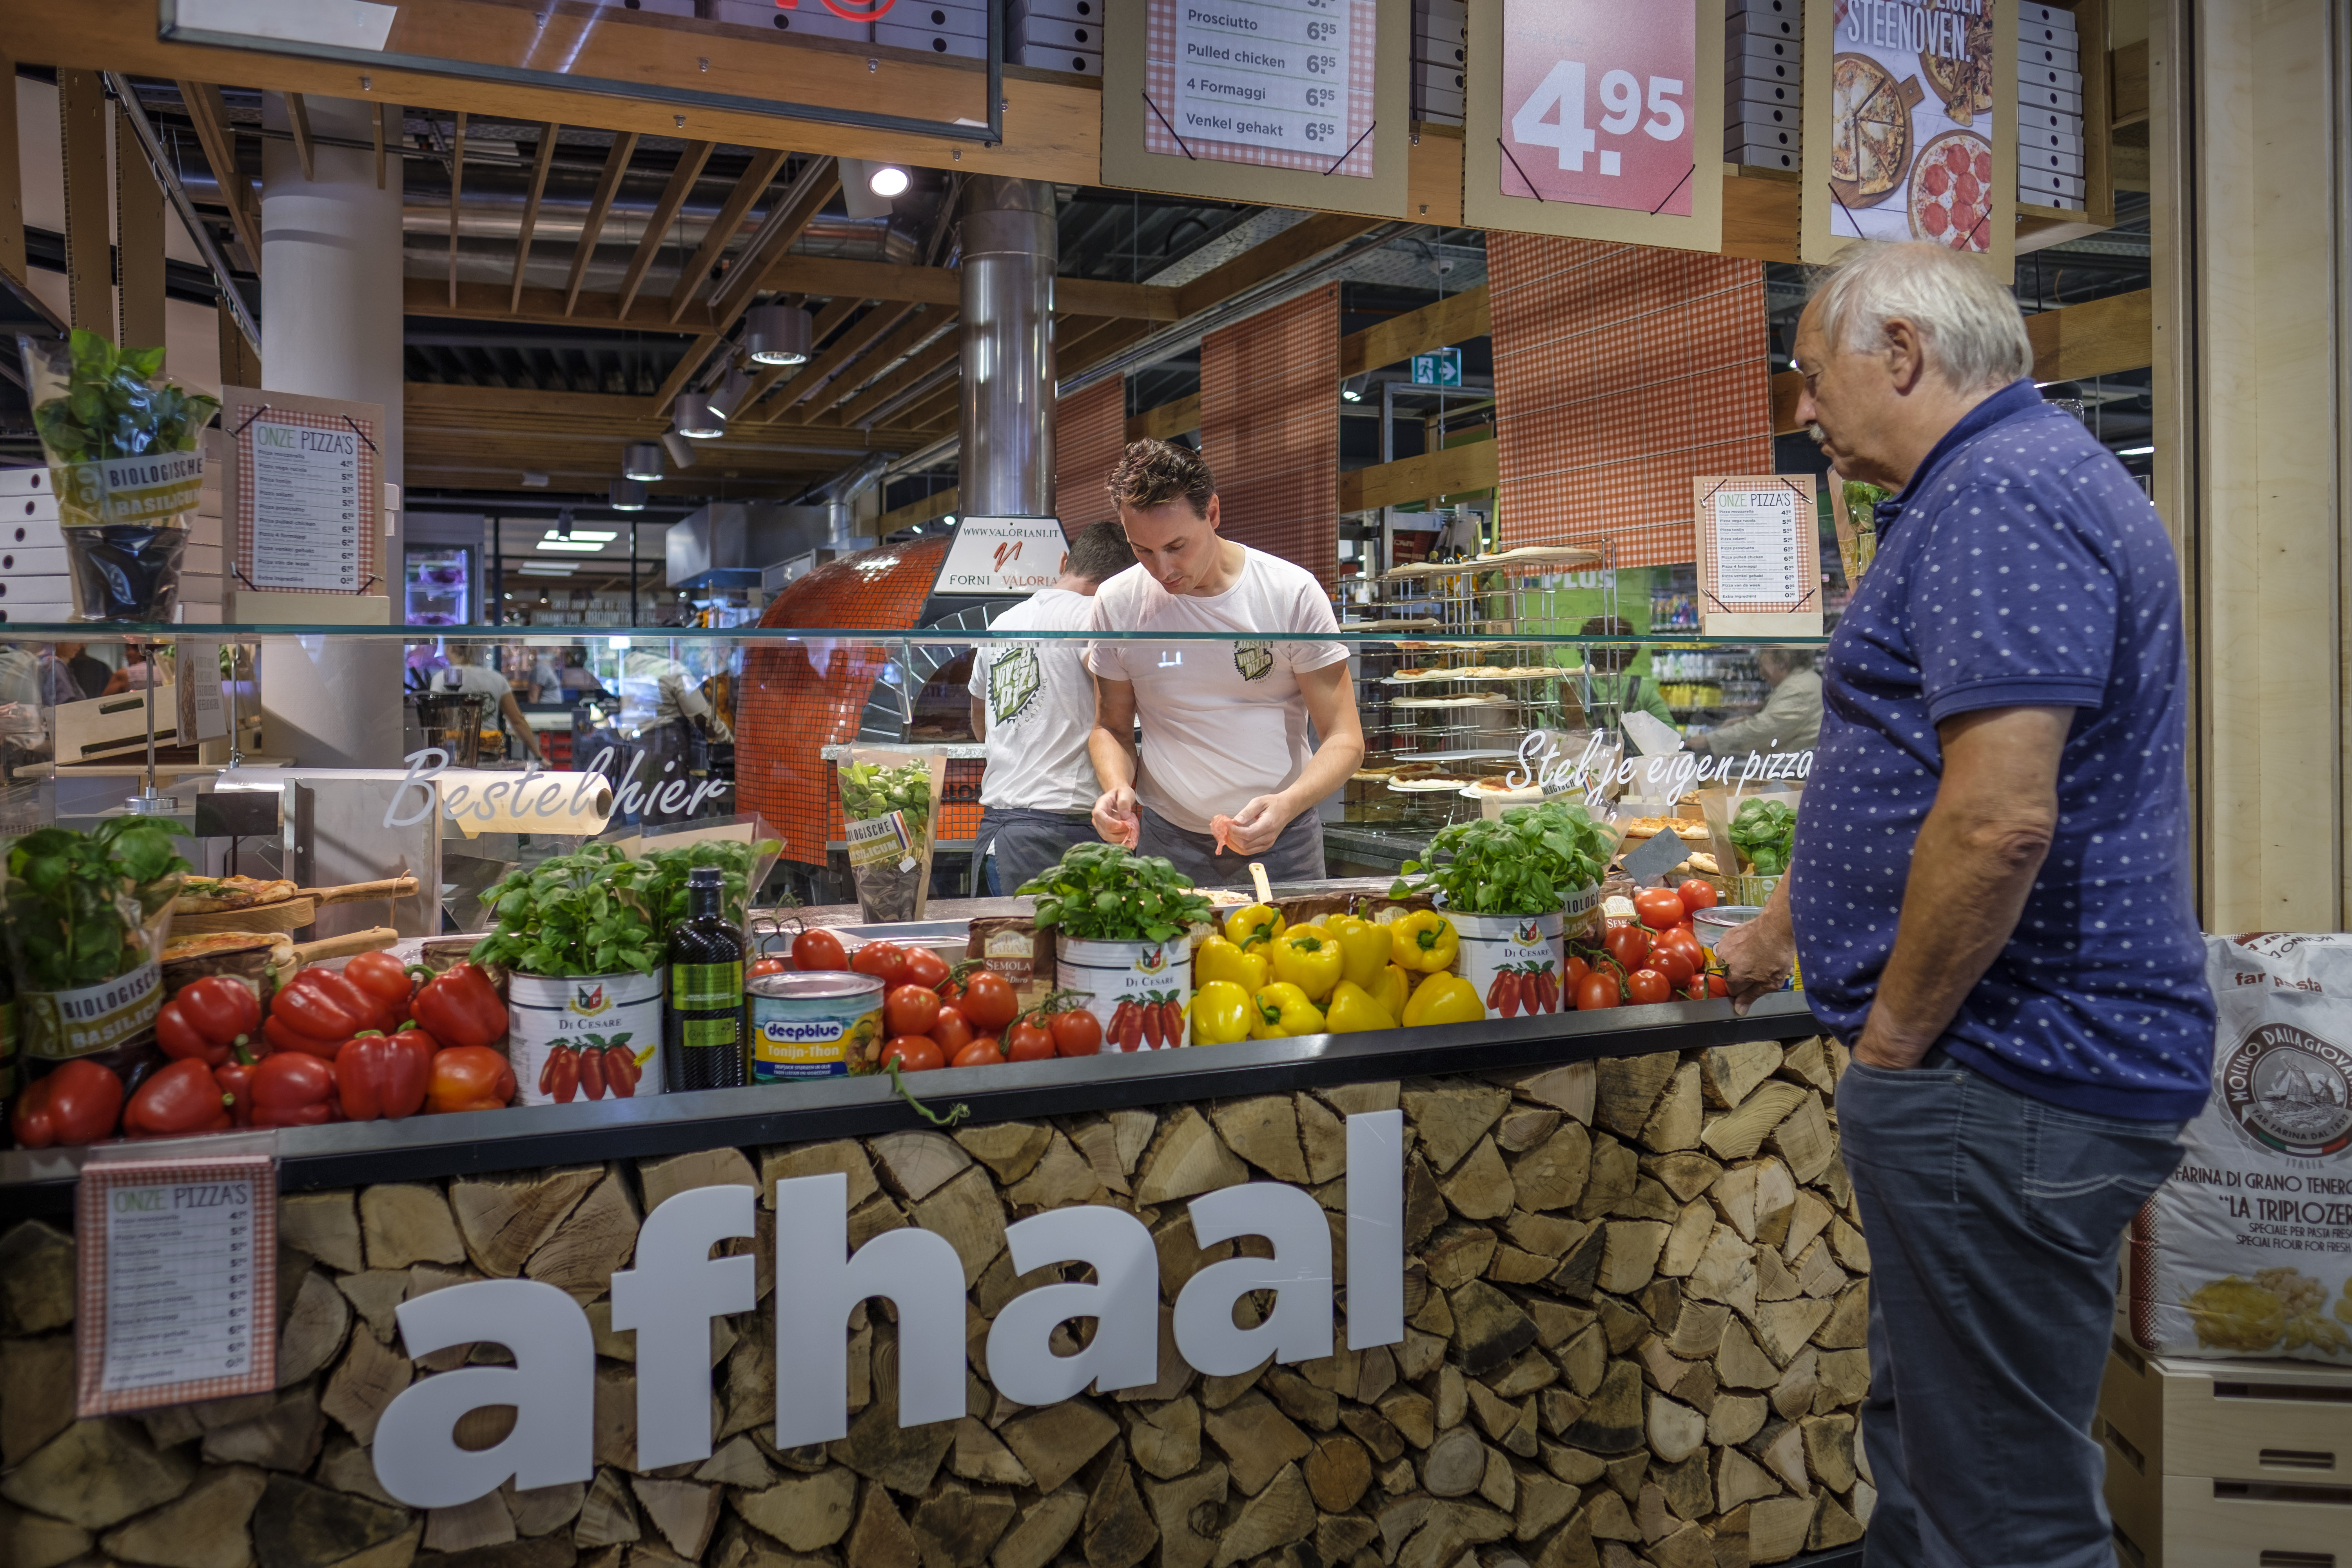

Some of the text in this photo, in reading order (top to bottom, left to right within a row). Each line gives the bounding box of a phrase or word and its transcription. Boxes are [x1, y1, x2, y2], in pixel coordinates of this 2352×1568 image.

[1188, 9, 1258, 30] Prosciutto
[1848, 0, 1971, 62] STEENOVEN.
[1188, 43, 1229, 60] Pulled
[1234, 51, 1285, 68] chicken
[1187, 78, 1195, 89] 4
[1201, 79, 1265, 100] Formaggi
[1186, 113, 1231, 129] Venkel
[1236, 122, 1283, 136] gehakt
[1512, 59, 1684, 176] 4.95
[257, 426, 353, 455] ONZE PIZZA'S
[110, 458, 203, 487] BIOLOGISCHE
[1719, 493, 1790, 507] ONZE PIZZA'S
[963, 528, 1059, 537] WWW.VALORIANI.IT
[949, 575, 1062, 586] FORNI VALORIA
[1544, 570, 1614, 588] PLUS
[1025, 678, 1048, 722] CATERING
[1506, 730, 1814, 807] Stel je eigen pizza
[383, 746, 726, 828] Bestel hier
[986, 959, 1031, 971] SEMOLA
[2235, 972, 2323, 993] far pasta
[768, 1023, 840, 1041] deepblue
[768, 1044, 840, 1060] Tonijn-Thon
[2229, 1042, 2261, 1102] MOLINO
[2252, 1109, 2350, 1140] FAR FARINA DAL 1832
[2285, 1157, 2325, 1170] ITALIA
[2175, 1165, 2223, 1186] FARINA
[2227, 1171, 2241, 1187] DI
[2245, 1172, 2303, 1192] GRANO
[113, 1188, 167, 1213] ONZE
[2249, 1222, 2288, 1236] SPECIALE
[2290, 1226, 2305, 1237] PER
[2307, 1227, 2330, 1238] PASTA
[2236, 1234, 2351, 1254] SPECIAL FLOUR FOR FRESH
[372, 1108, 1404, 1509] afhaal
